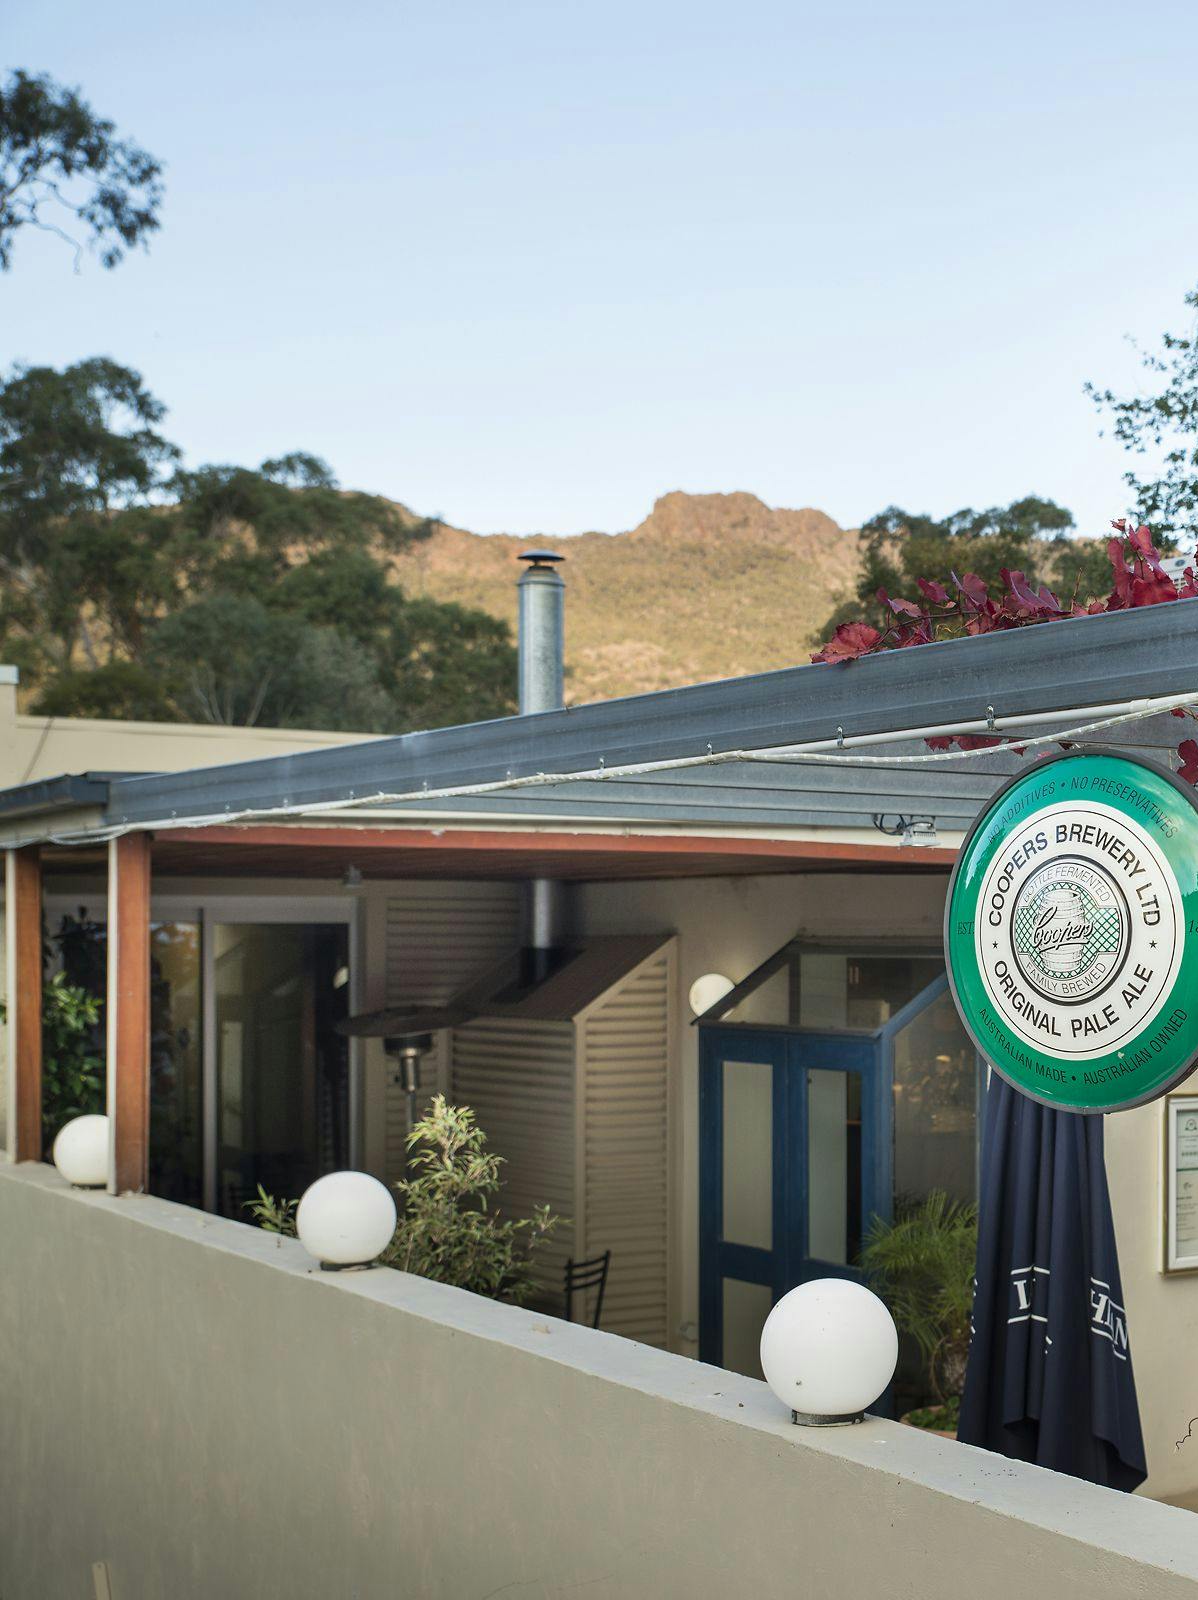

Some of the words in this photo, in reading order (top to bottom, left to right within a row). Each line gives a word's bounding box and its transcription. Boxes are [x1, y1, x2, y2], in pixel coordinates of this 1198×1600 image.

[987, 824, 1001, 844] NO
[1001, 781, 1055, 825] ADDITIVES
[1070, 776, 1088, 790] NO
[1091, 777, 1178, 838] PRESERVATIVES
[989, 832, 1048, 926] COOPERS
[1056, 823, 1146, 878] BREWERY
[1135, 883, 1161, 926] LTD
[1023, 871, 1053, 903] BOTTLE
[1055, 866, 1111, 902] FERMENTED
[1033, 906, 1094, 953] Coopers
[994, 960, 1062, 1037] ORIGINAL
[1071, 1004, 1120, 1038] PALE
[1121, 964, 1154, 1009] ALE
[1026, 962, 1058, 992] FAMILY
[1062, 962, 1106, 994] BREWED
[980, 1008, 1033, 1071] AUSTRALIAN
[1035, 1062, 1067, 1084] MADE
[1084, 1048, 1153, 1085] AUSTRALIAN
[1149, 1008, 1188, 1053] OWNED
